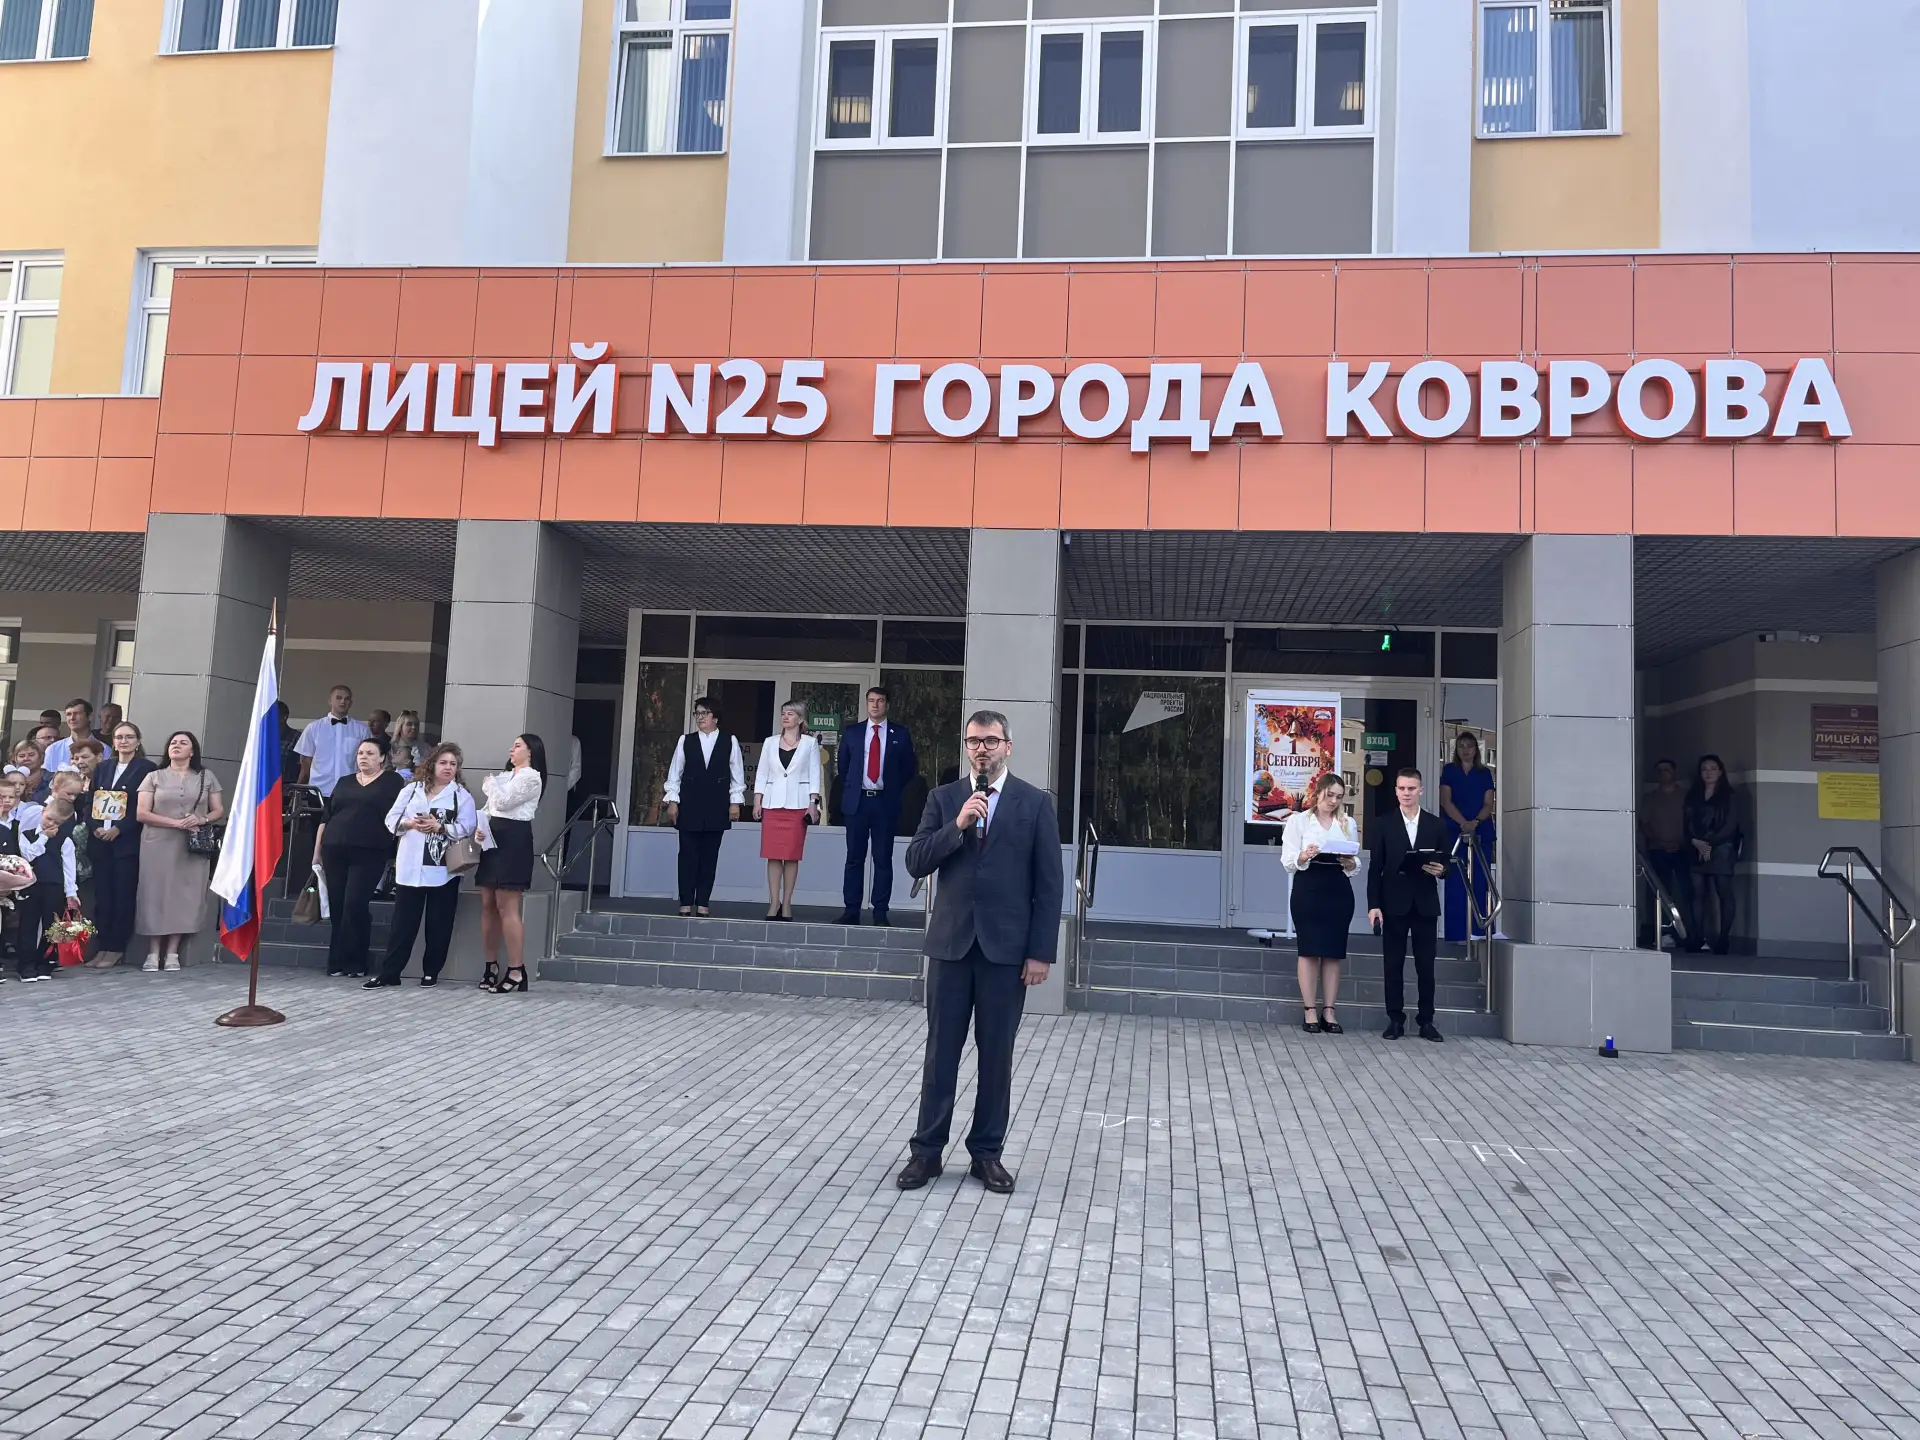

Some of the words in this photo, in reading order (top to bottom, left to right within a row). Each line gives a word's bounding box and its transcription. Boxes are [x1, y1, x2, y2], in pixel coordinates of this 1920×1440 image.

[297, 342, 618, 447] ЛИЦЕЙ
[648, 359, 829, 437] N25
[873, 363, 1284, 452] ГОРОДА
[1326, 358, 1853, 440] КОВРОВА
[1143, 692, 1184, 700] НАЦИОНАЛЬНЫЕ
[814, 717, 834, 726] ВХОД
[1366, 736, 1390, 746] ВХОД
[1815, 733, 1860, 744] ЛИЦЕЙ
[1289, 739, 1298, 755] 1
[1267, 752, 1320, 768] СЕНТЯБРЯ
